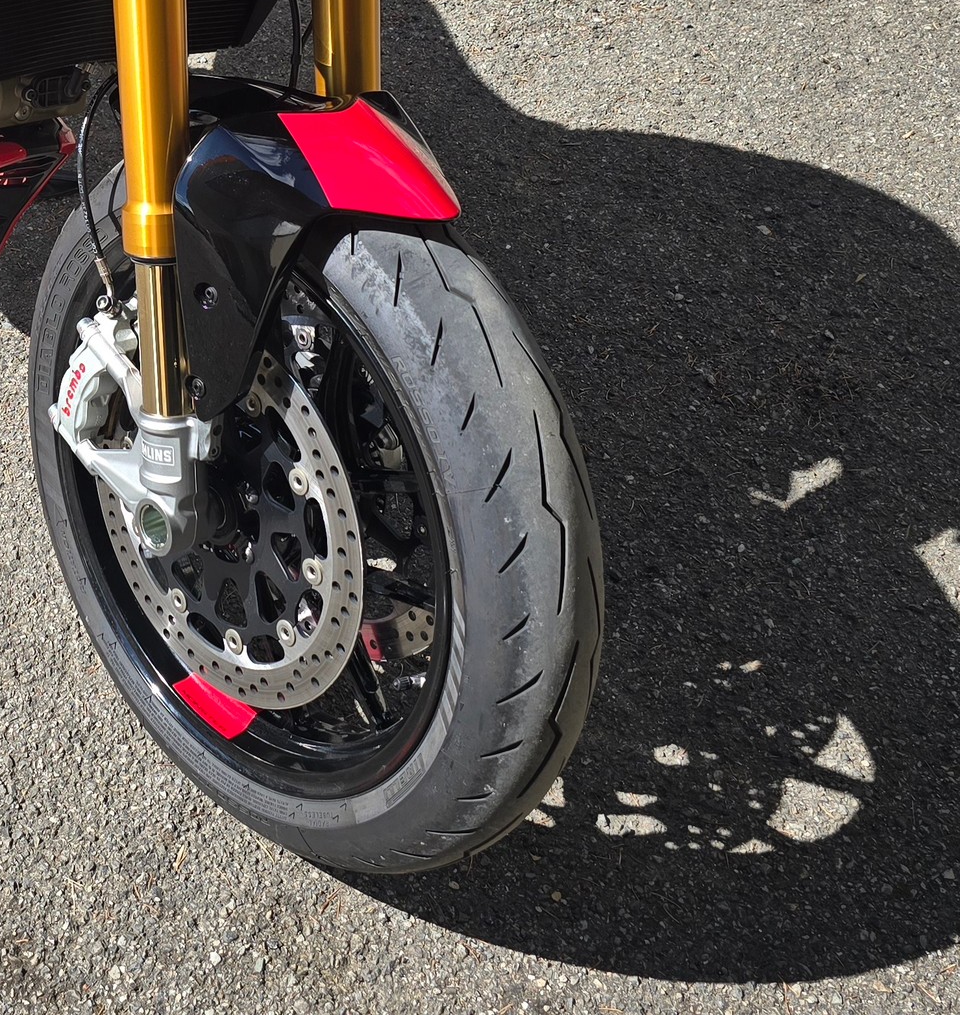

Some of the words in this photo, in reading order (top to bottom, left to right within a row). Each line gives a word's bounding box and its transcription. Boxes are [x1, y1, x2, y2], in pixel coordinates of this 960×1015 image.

[35, 296, 67, 396] DIABLO
[61, 363, 87, 418] brembo
[391, 355, 441, 444] ROSSO
